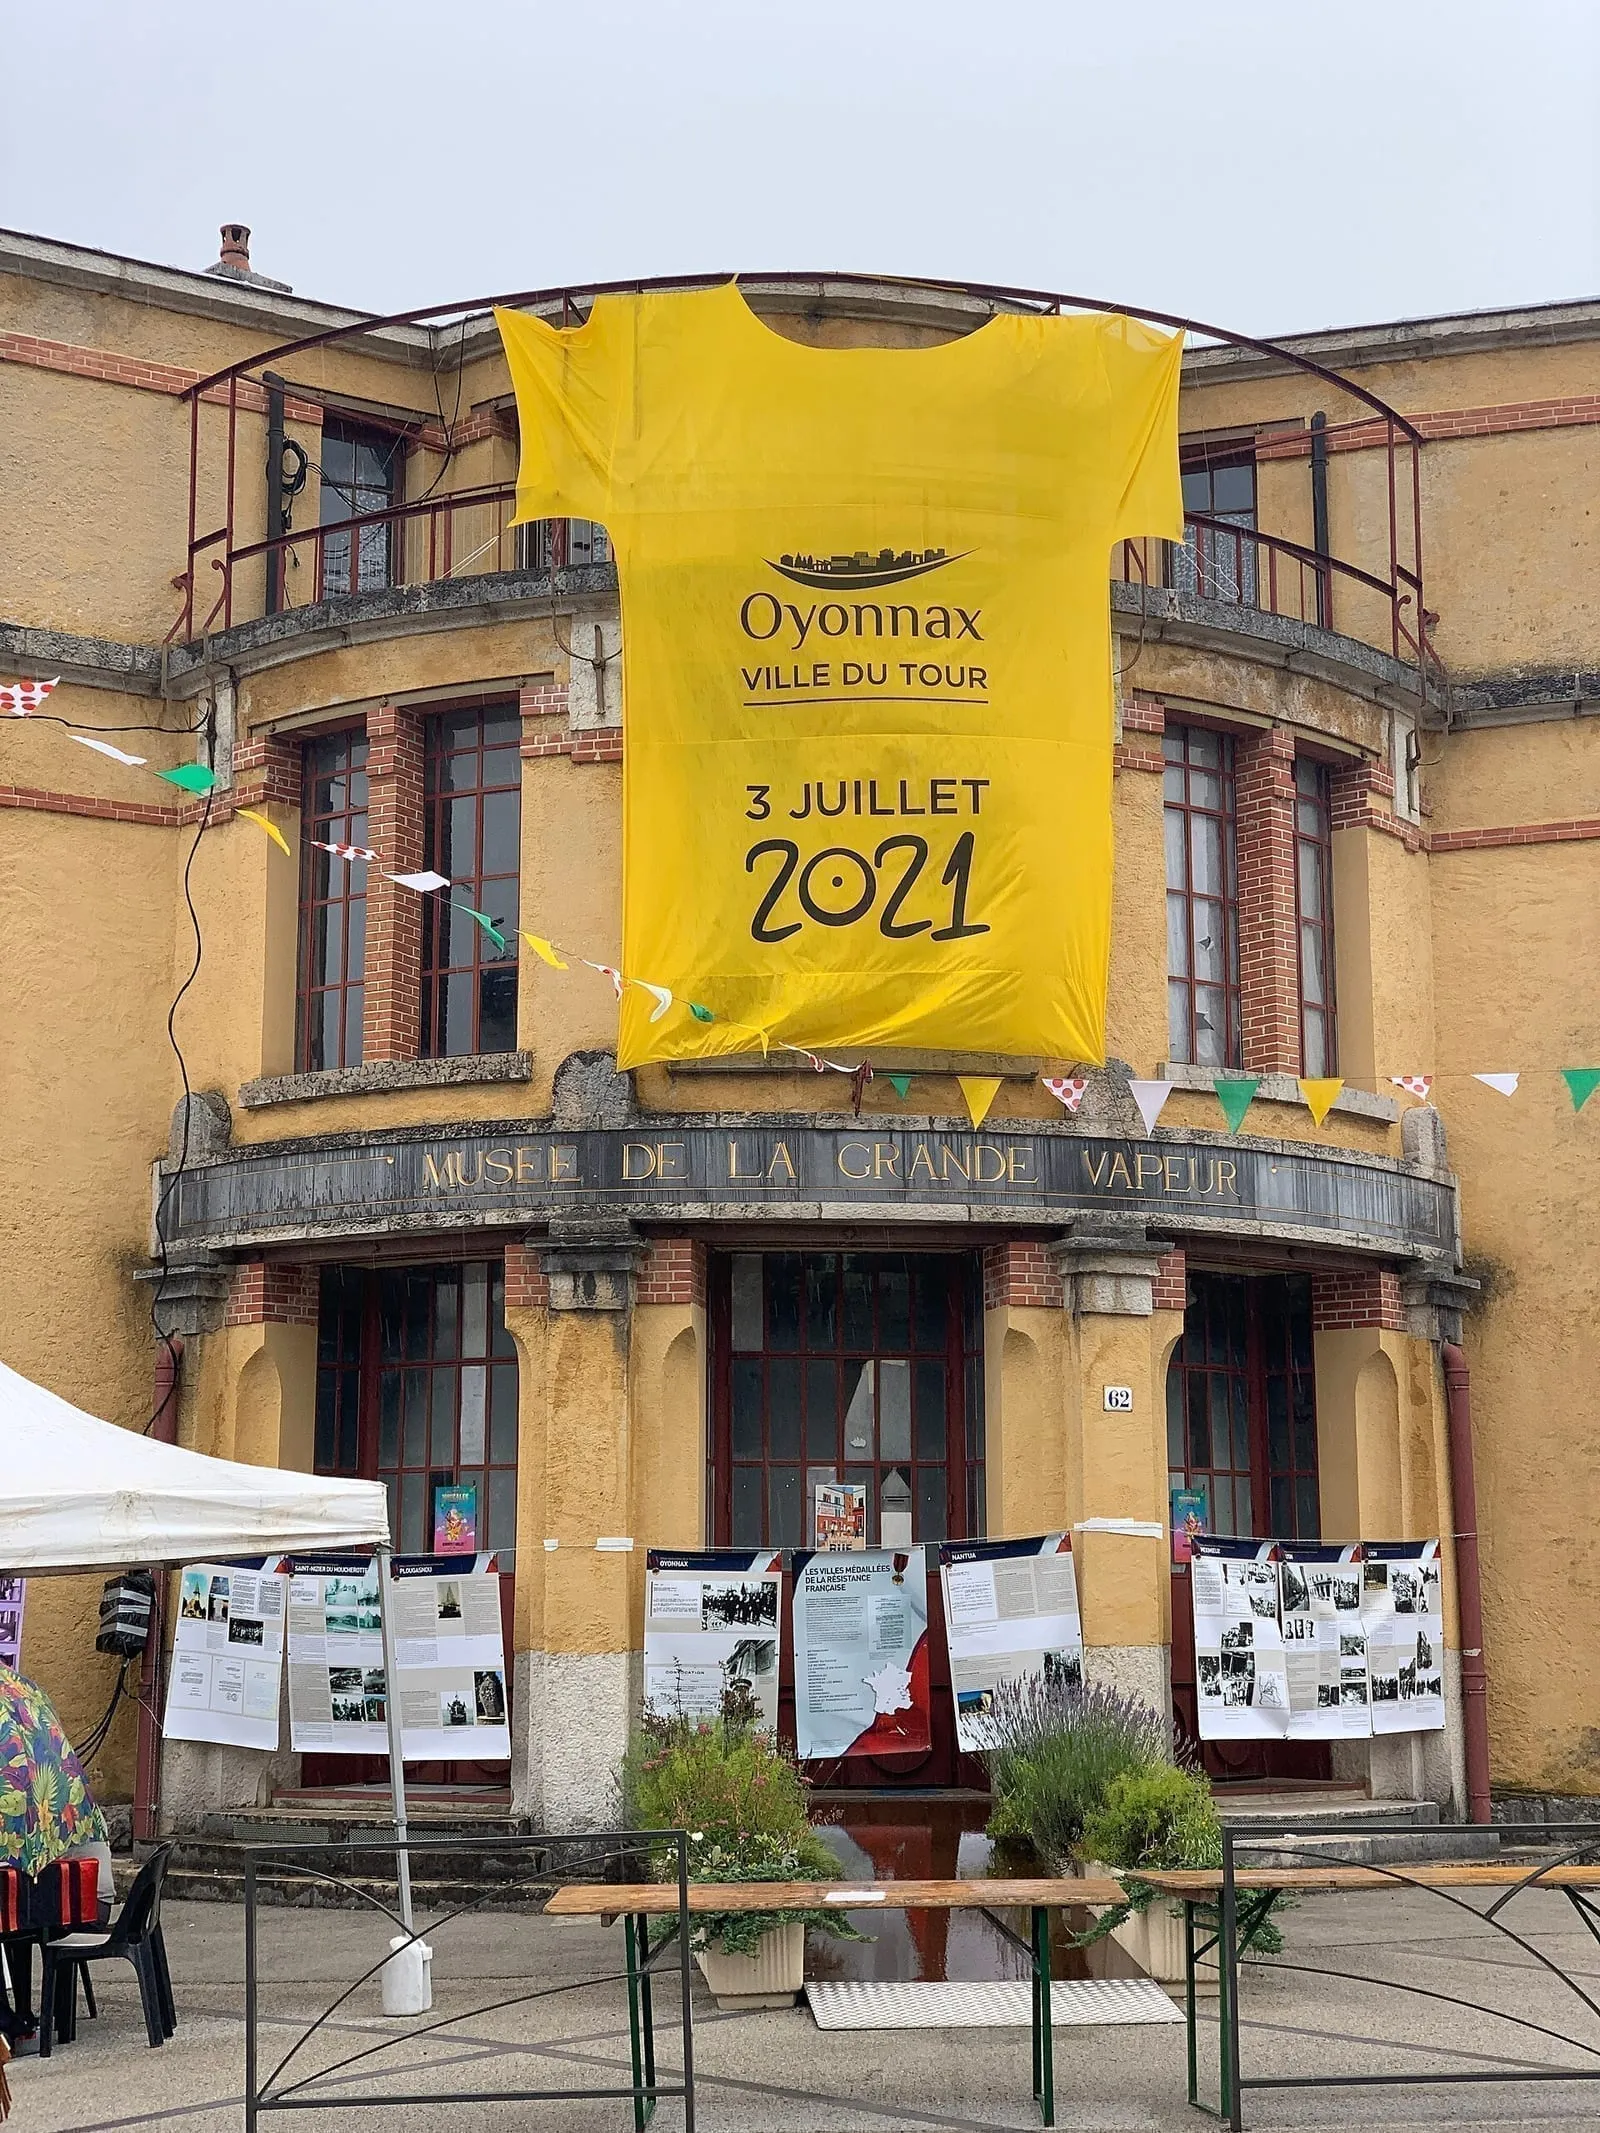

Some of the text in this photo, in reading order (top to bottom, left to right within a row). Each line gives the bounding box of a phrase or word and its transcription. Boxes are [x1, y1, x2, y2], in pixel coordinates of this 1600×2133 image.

[740, 591, 985, 650] Oyonnax
[741, 662, 988, 690] VILLE DU TOUR
[745, 778, 990, 821] 3 JUILLET
[745, 831, 991, 944] 2021
[422, 1139, 1241, 1198] MUSEE DE LA GRANDE VAPEUR
[1108, 1389, 1130, 1408] 62
[805, 1563, 891, 1576] LES VILLES MÉDAILLÉES
[805, 1573, 872, 1584] DE LA RÉSISTANCE
[805, 1584, 847, 1593] FRANÇAISE
